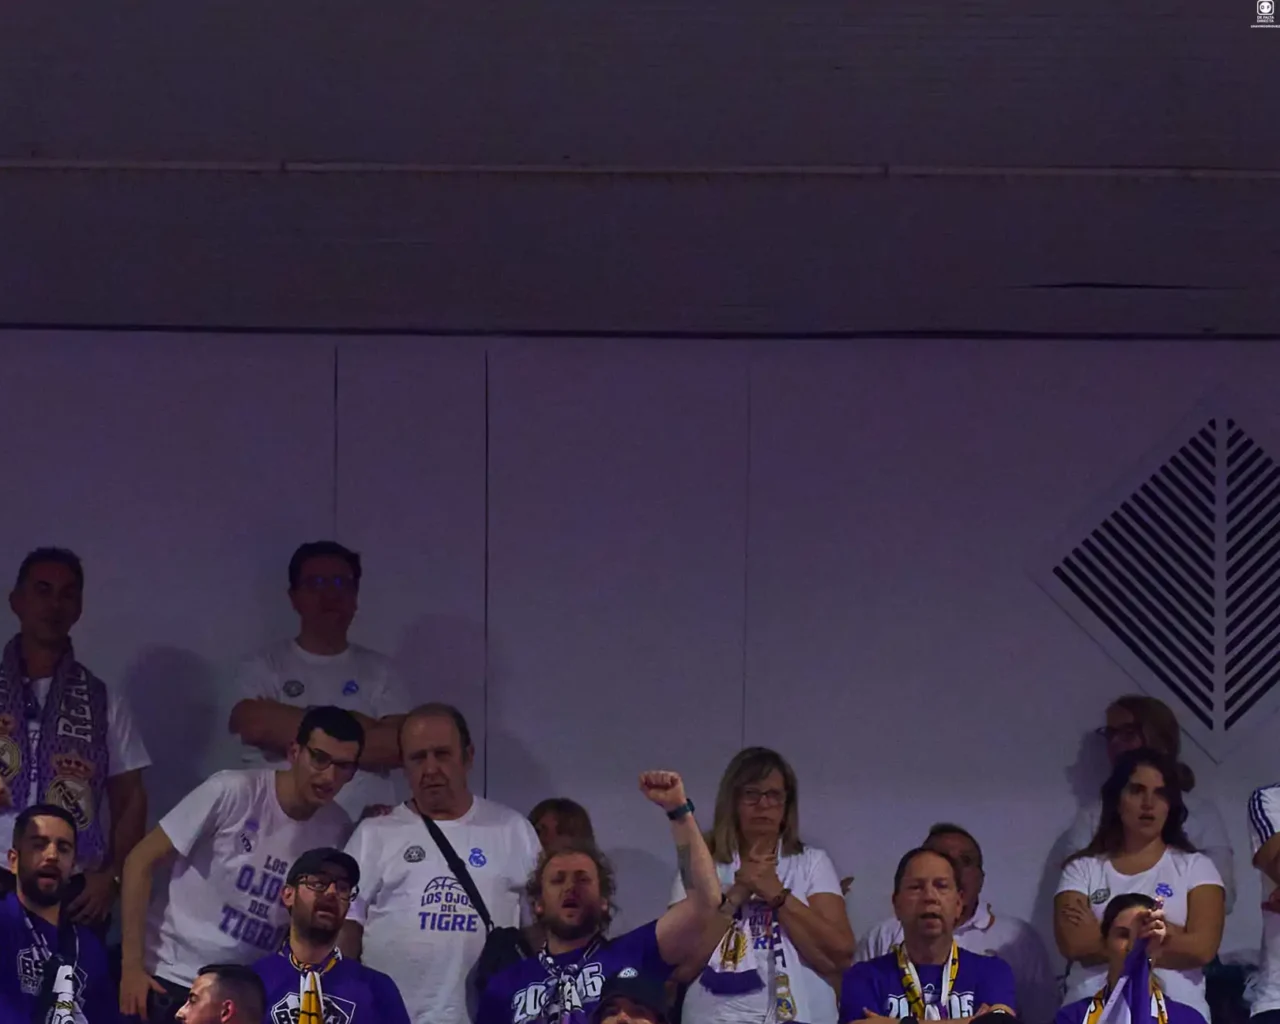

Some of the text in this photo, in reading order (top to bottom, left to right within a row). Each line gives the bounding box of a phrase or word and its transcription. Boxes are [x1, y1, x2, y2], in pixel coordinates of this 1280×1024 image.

[264, 855, 288, 875] LOS
[236, 864, 283, 904] OJO
[420, 892, 442, 907] LOS
[440, 904, 458, 913] DEL
[418, 912, 479, 932] TIGRE
